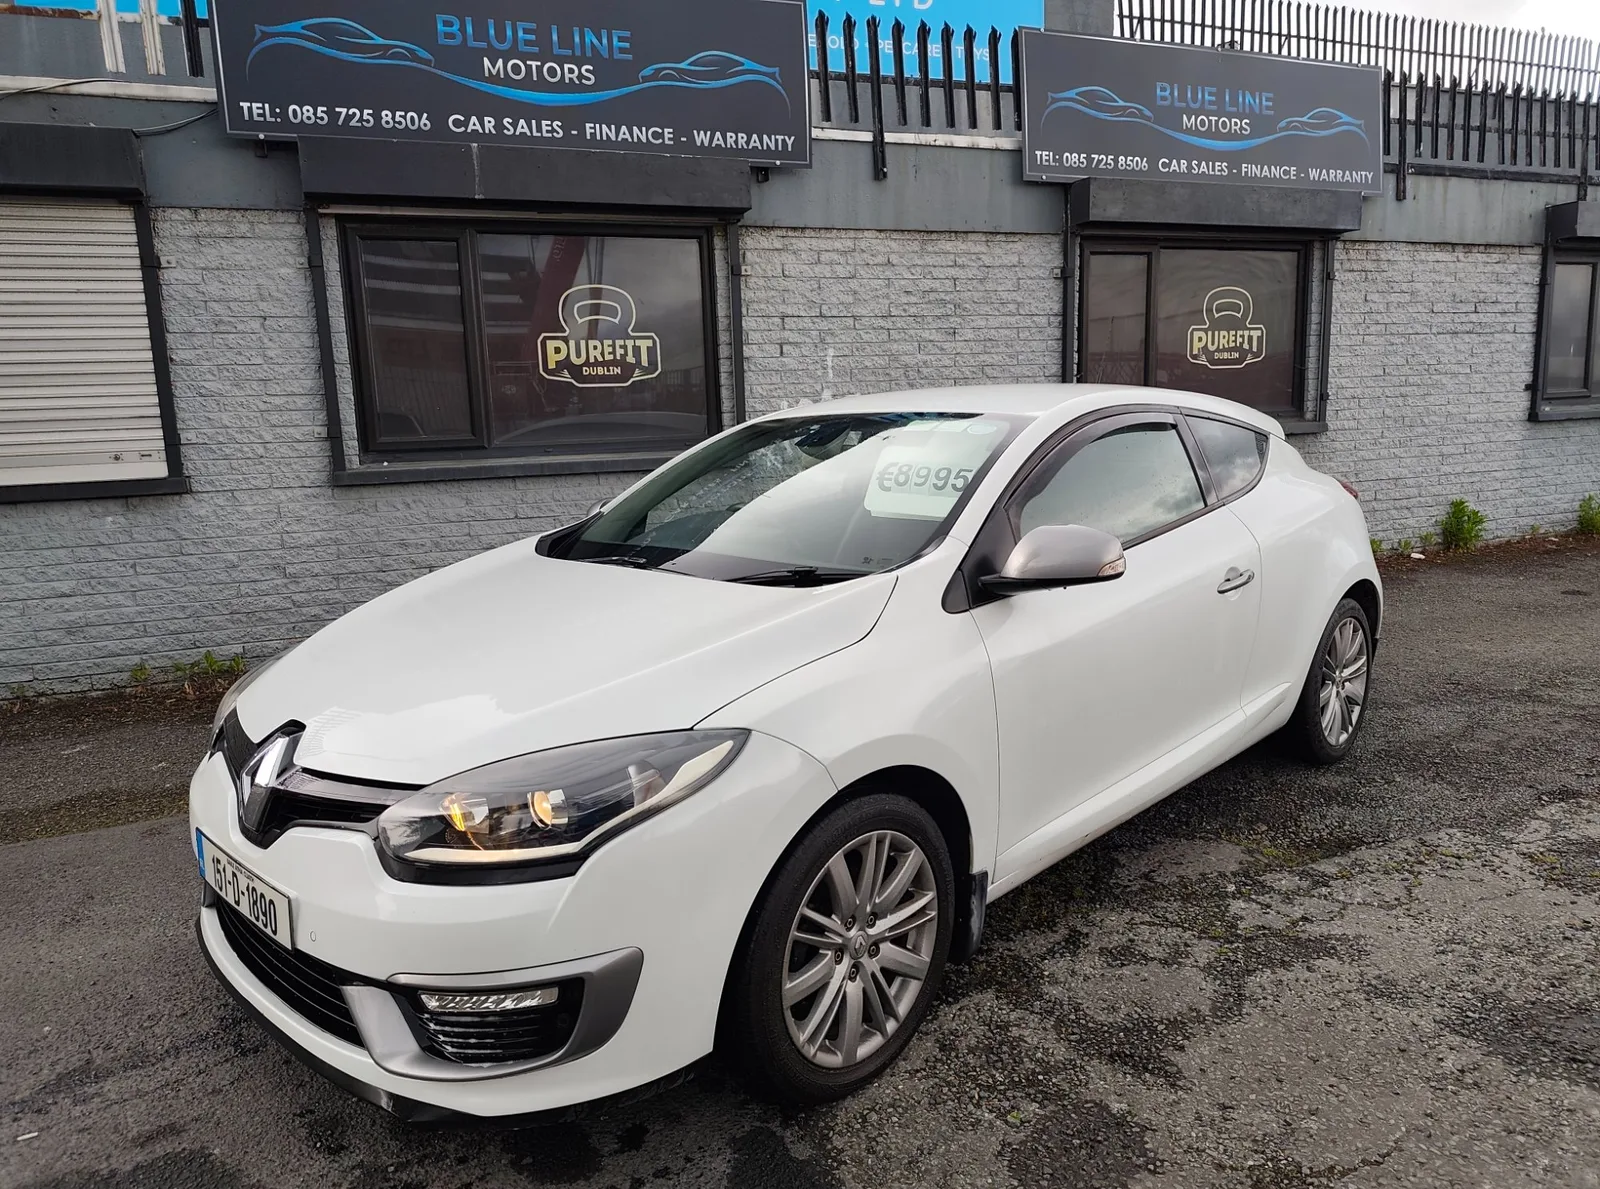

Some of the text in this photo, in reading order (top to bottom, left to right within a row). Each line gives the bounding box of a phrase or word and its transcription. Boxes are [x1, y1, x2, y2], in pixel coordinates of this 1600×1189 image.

[435, 13, 633, 61] BLUE LINE
[483, 56, 596, 86] MOTORS
[1156, 81, 1275, 116] BLUE LINE
[239, 101, 281, 123] TEL:
[288, 103, 329, 126] 085
[335, 107, 375, 128] 725
[380, 109, 432, 132] 8506
[448, 114, 497, 136] CAR
[502, 117, 564, 139] SALES
[585, 122, 674, 145] FINANCE
[692, 129, 796, 152] WARRANTY
[1182, 113, 1251, 136] MOTORS
[1034, 150, 1059, 167] TEL:
[1062, 152, 1087, 169] 085
[1090, 154, 1115, 170] 725
[1117, 155, 1149, 172] 8506
[1158, 157, 1188, 174] CAR
[1191, 159, 1228, 177] SALES
[1241, 163, 1297, 180] FINANCE
[1308, 167, 1374, 184] WARRANTY
[545, 339, 653, 370] PUREFIT
[1192, 330, 1262, 355] PUREFIT
[1214, 351, 1240, 360] DUBLIN
[582, 366, 621, 376] DUBLIN
[876, 461, 974, 493] €8995
[212, 854, 278, 937] 151-D-1890
